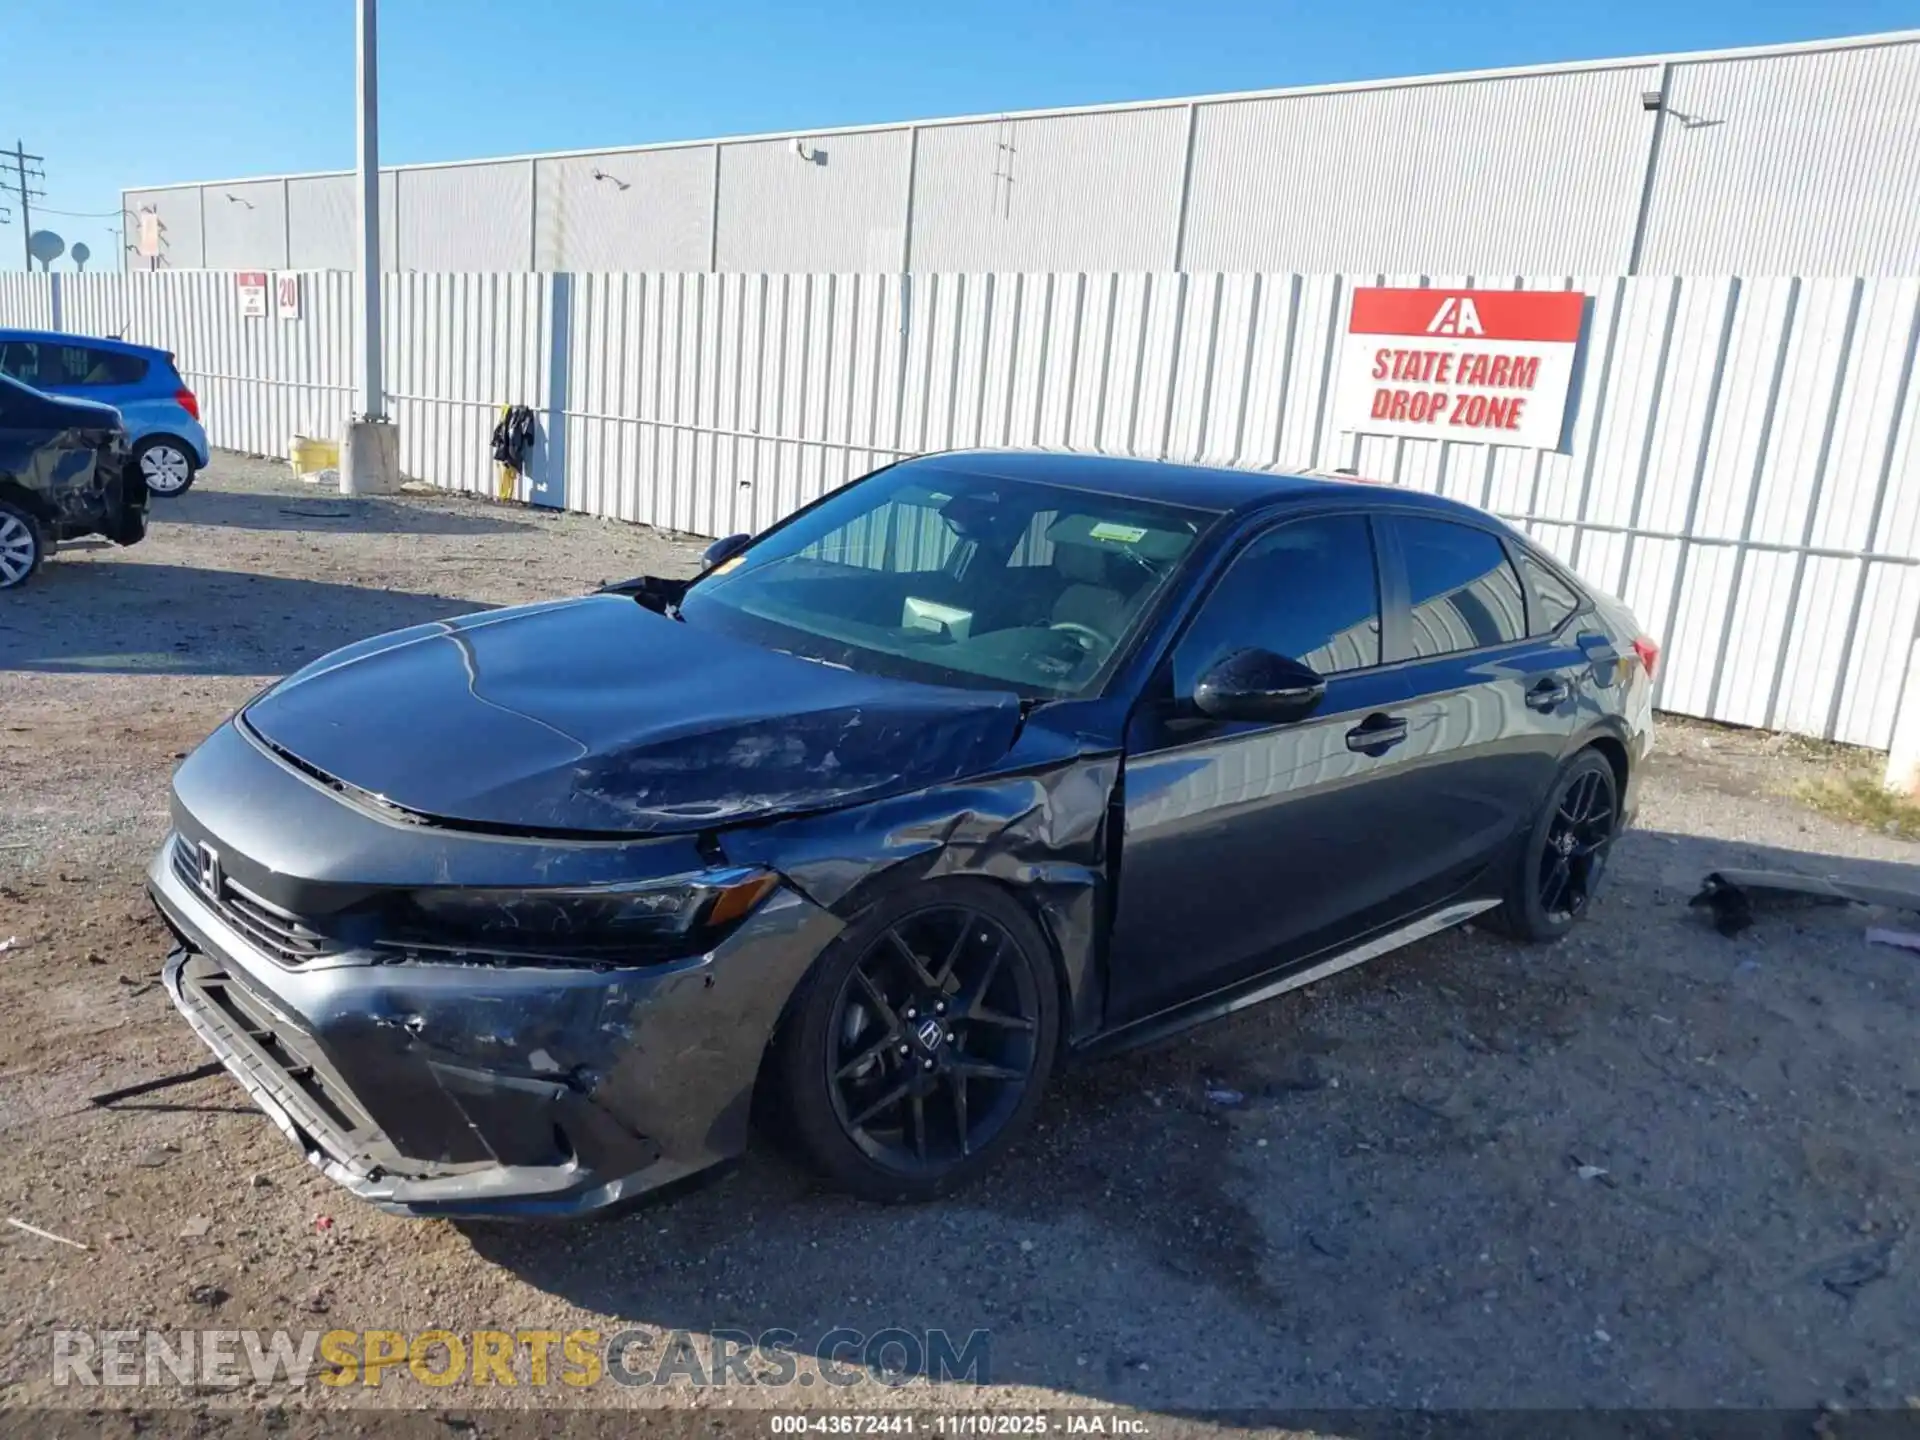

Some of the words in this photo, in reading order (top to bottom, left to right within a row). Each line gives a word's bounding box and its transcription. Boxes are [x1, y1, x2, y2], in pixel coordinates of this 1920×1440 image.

[279, 277, 296, 308] 20
[1372, 349, 1452, 382] STATE
[1455, 353, 1539, 388] FARM
[1371, 389, 1447, 422] DROP
[1450, 395, 1525, 429] ZONE
